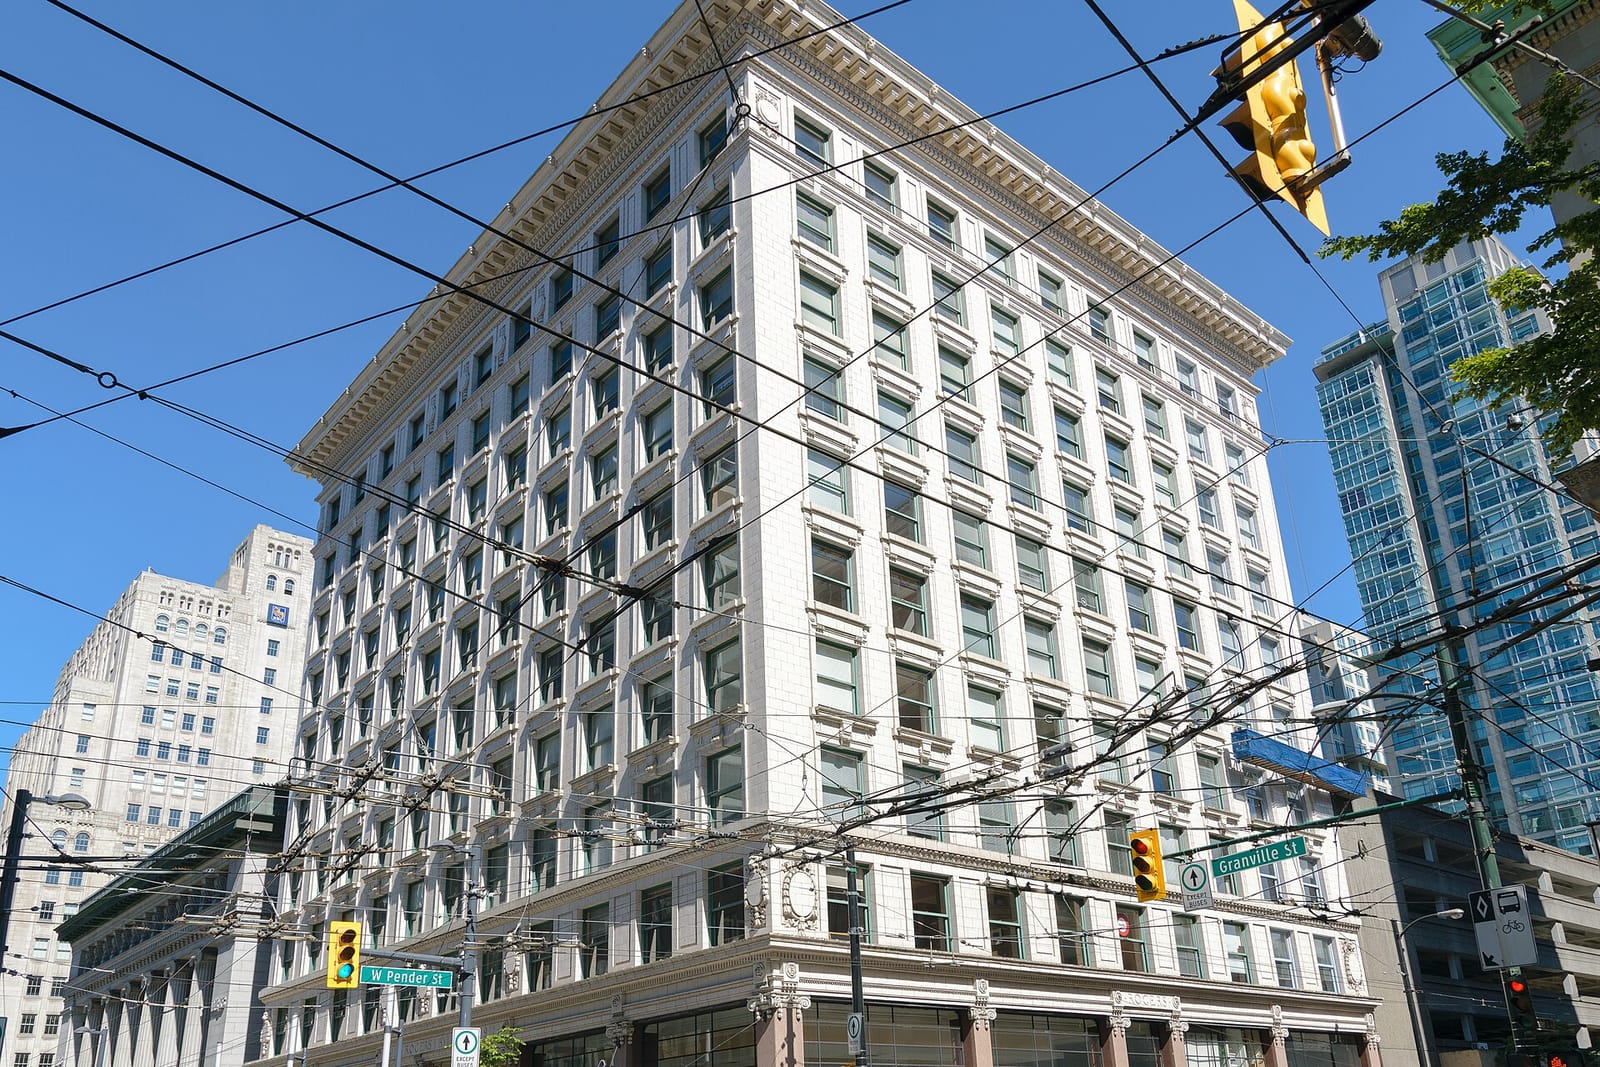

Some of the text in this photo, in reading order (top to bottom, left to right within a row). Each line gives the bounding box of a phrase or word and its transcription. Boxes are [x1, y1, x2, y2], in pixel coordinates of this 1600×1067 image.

[1219, 841, 1298, 873] Granville St
[1188, 899, 1208, 908] BUSES
[371, 968, 443, 986] W Pender St
